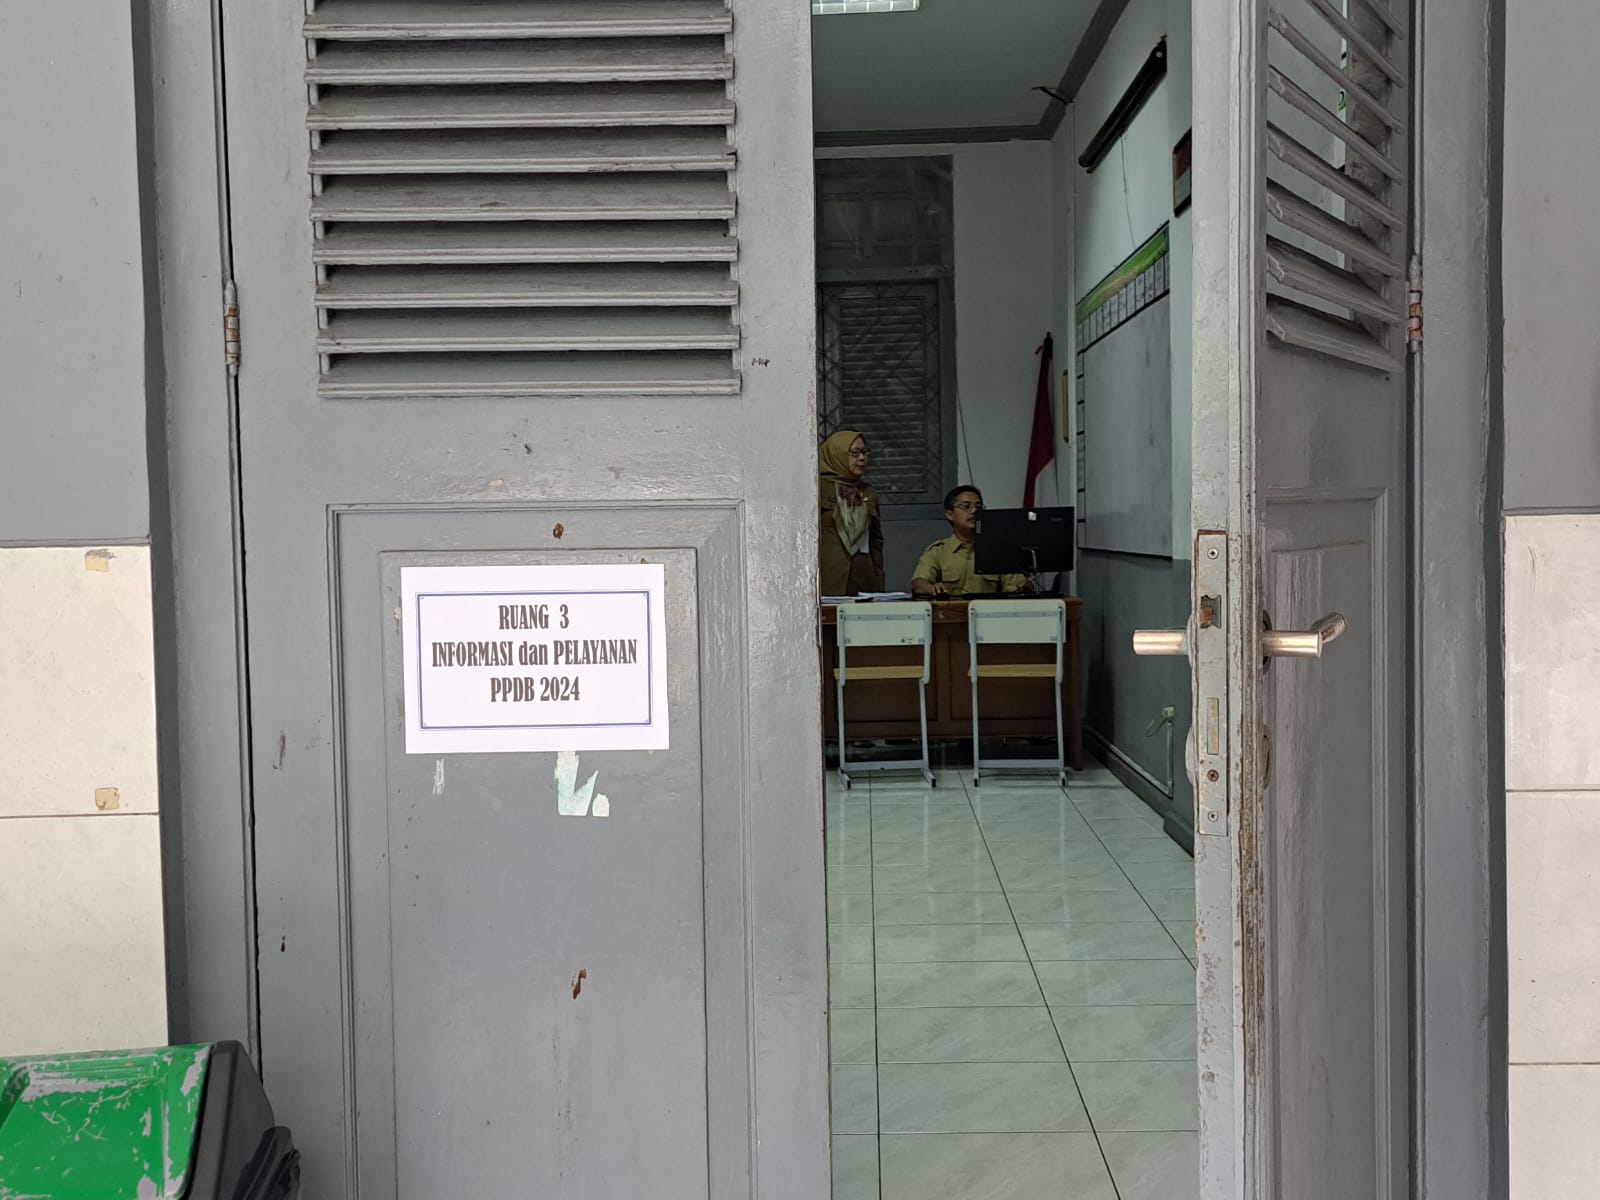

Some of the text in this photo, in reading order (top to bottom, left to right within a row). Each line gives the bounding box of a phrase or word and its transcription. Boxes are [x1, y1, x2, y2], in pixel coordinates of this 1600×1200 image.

[498, 603, 570, 630] RUANG 3
[432, 639, 637, 667] INFORMASI dan PELAYANAN
[490, 676, 580, 702] PPDB 2024
